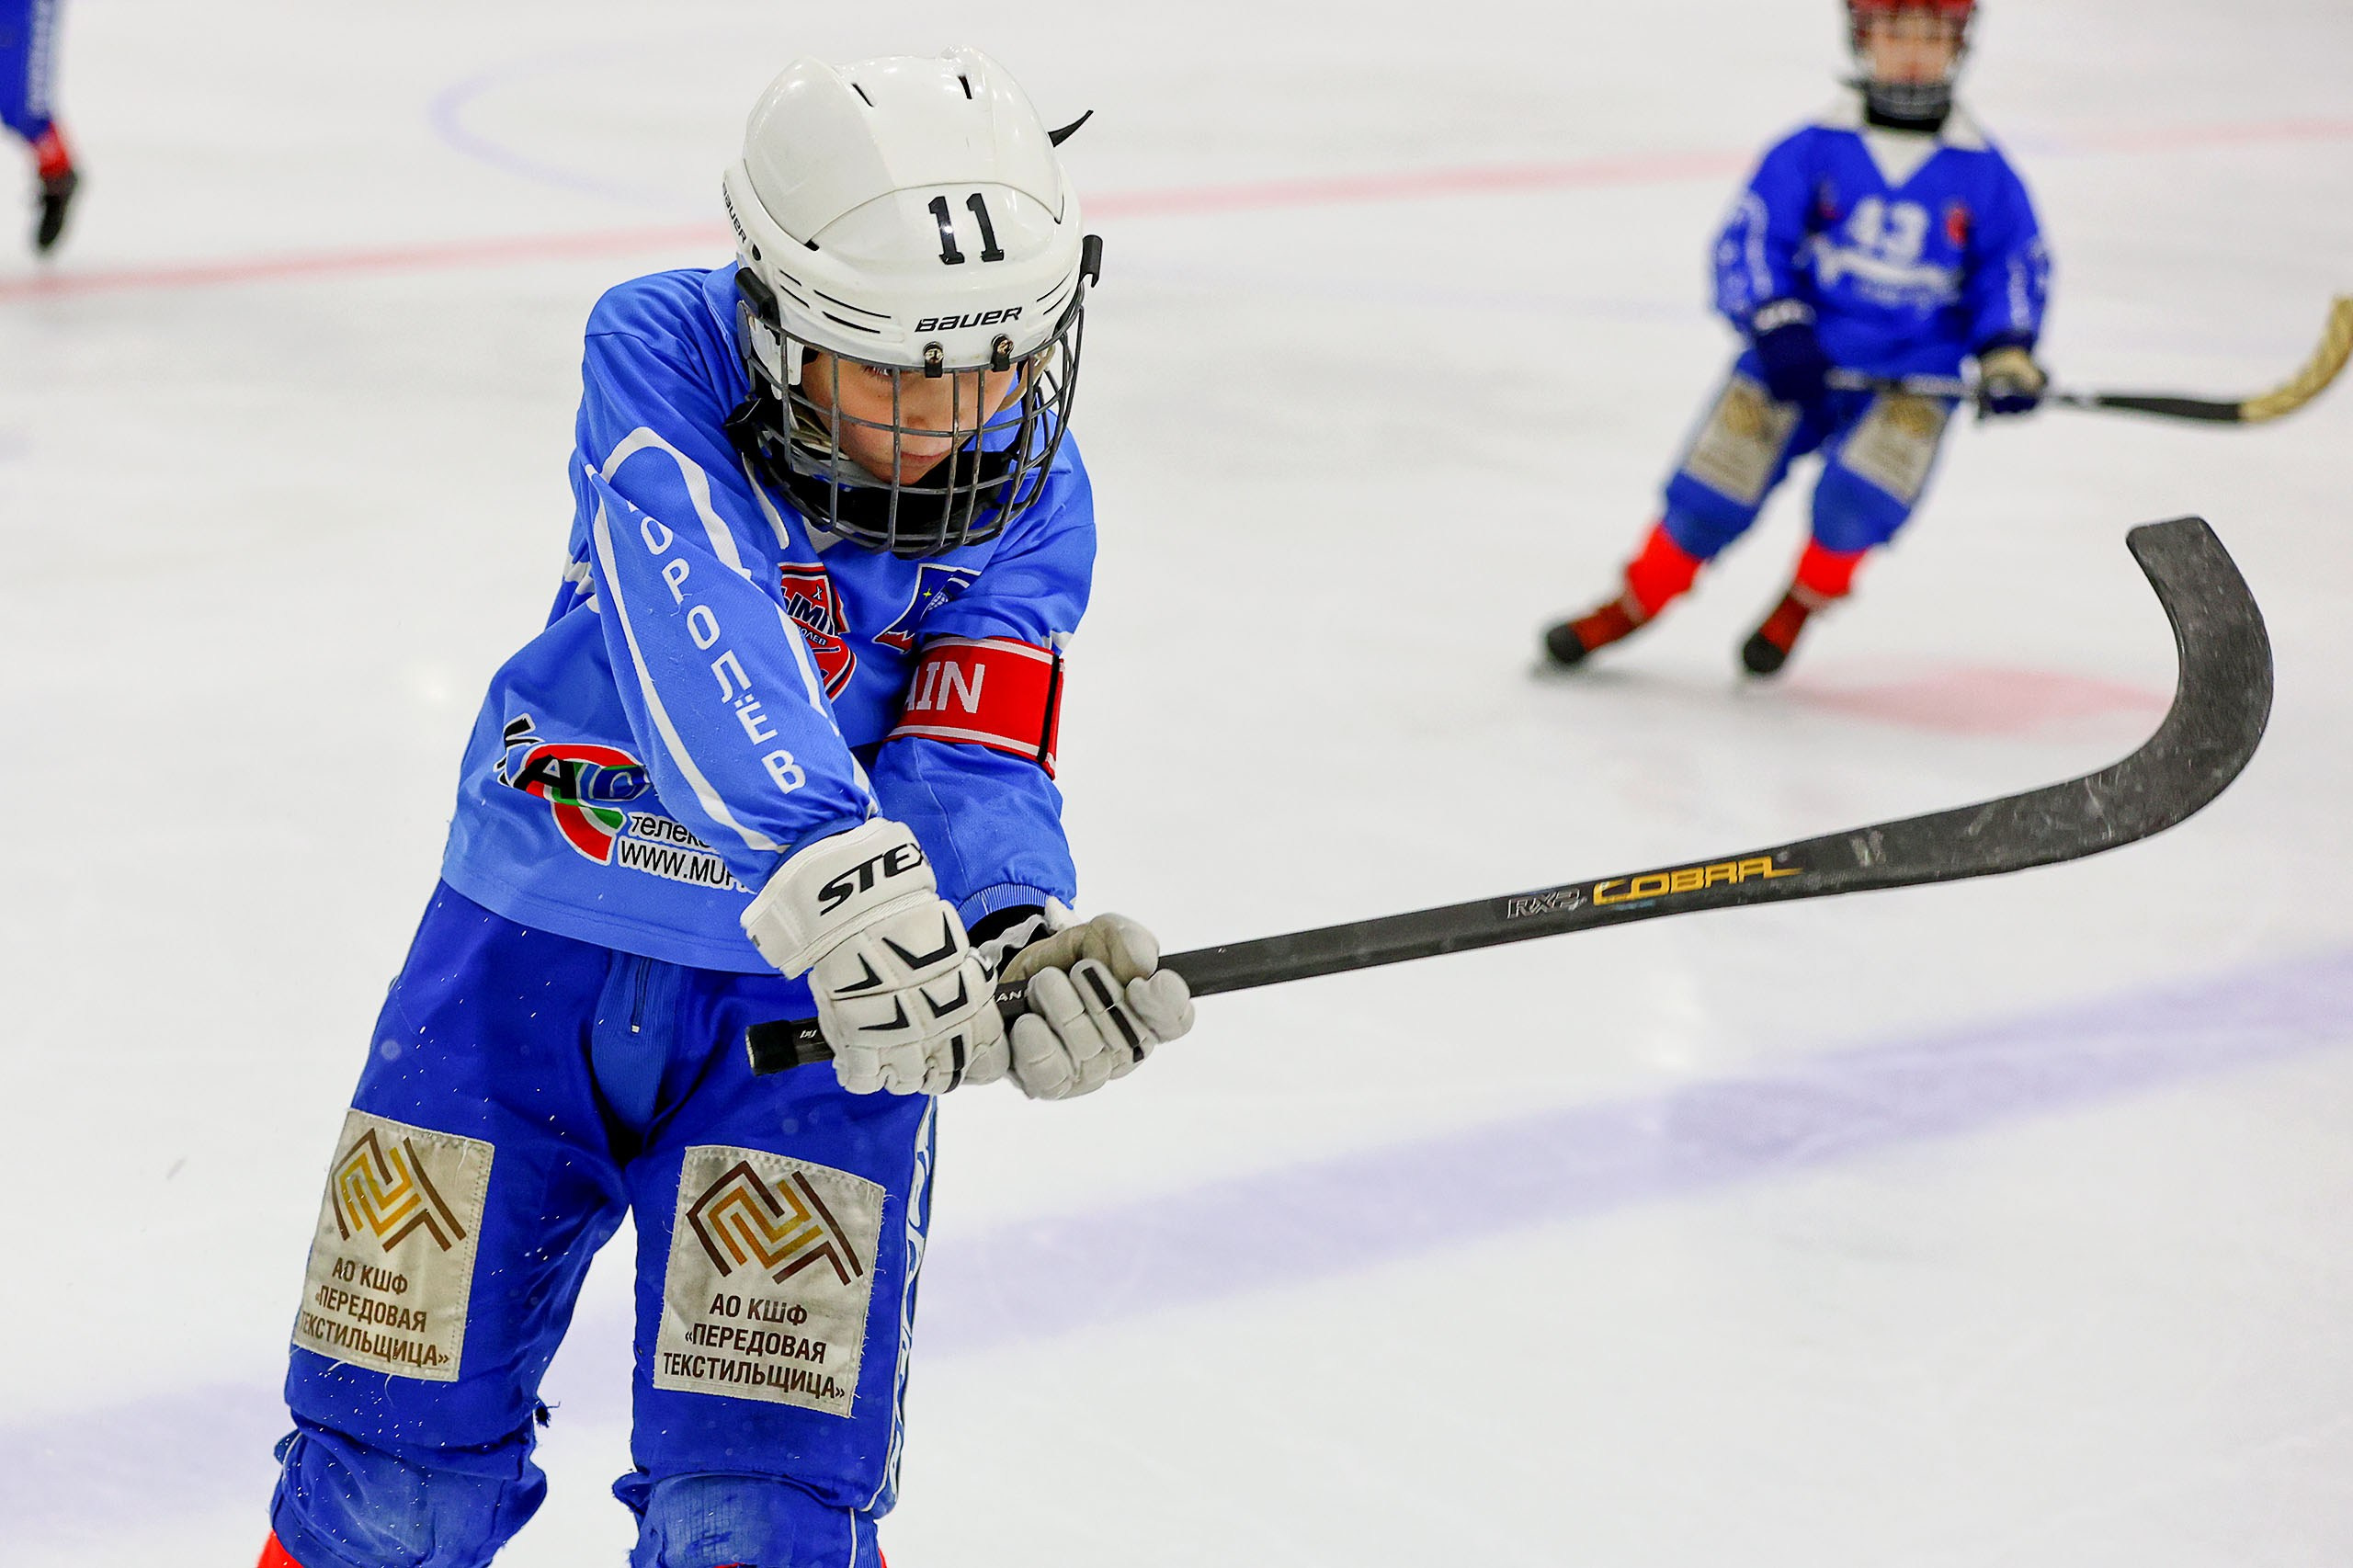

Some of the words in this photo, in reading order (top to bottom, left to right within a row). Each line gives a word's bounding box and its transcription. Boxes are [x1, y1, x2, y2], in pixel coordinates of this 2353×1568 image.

[928, 193, 1004, 265] 11
[915, 306, 1022, 333] BAUER
[629, 502, 806, 794] ОРОЛЁВ
[1593, 856, 1803, 906] COBRA
[332, 1256, 356, 1282] АО
[360, 1265, 408, 1295] КШФ
[710, 1293, 741, 1317] АО
[747, 1298, 808, 1326] КШФ
[685, 1323, 826, 1364] «ПЕРЕДОВАЯ
[664, 1352, 846, 1399] ТЕКСТИЛЬЩИЦА»
